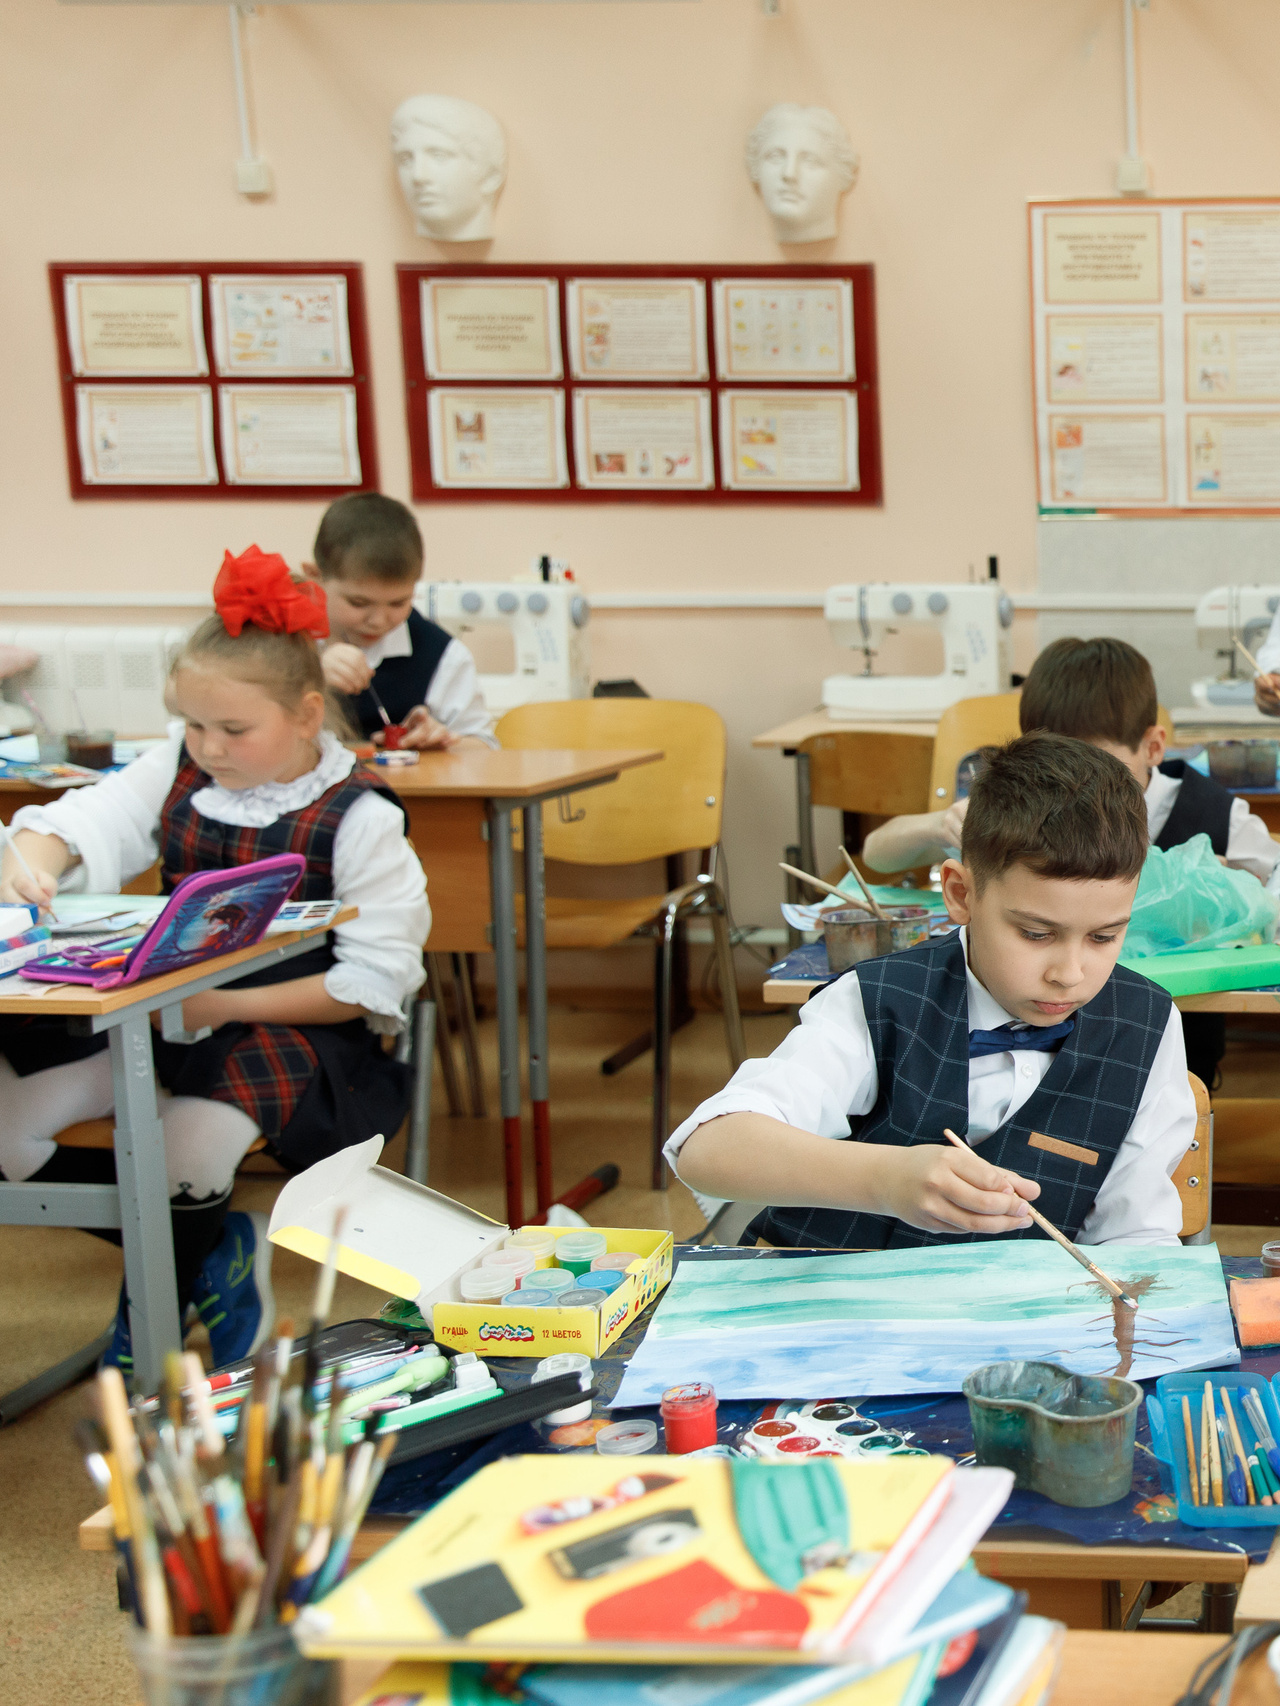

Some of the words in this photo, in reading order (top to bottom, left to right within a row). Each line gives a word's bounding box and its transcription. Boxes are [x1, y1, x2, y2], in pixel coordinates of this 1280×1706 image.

[441, 1325, 469, 1336] ГУАШЬ
[542, 1329, 550, 1339] 12
[552, 1329, 582, 1339] ЦВЕТОВ
